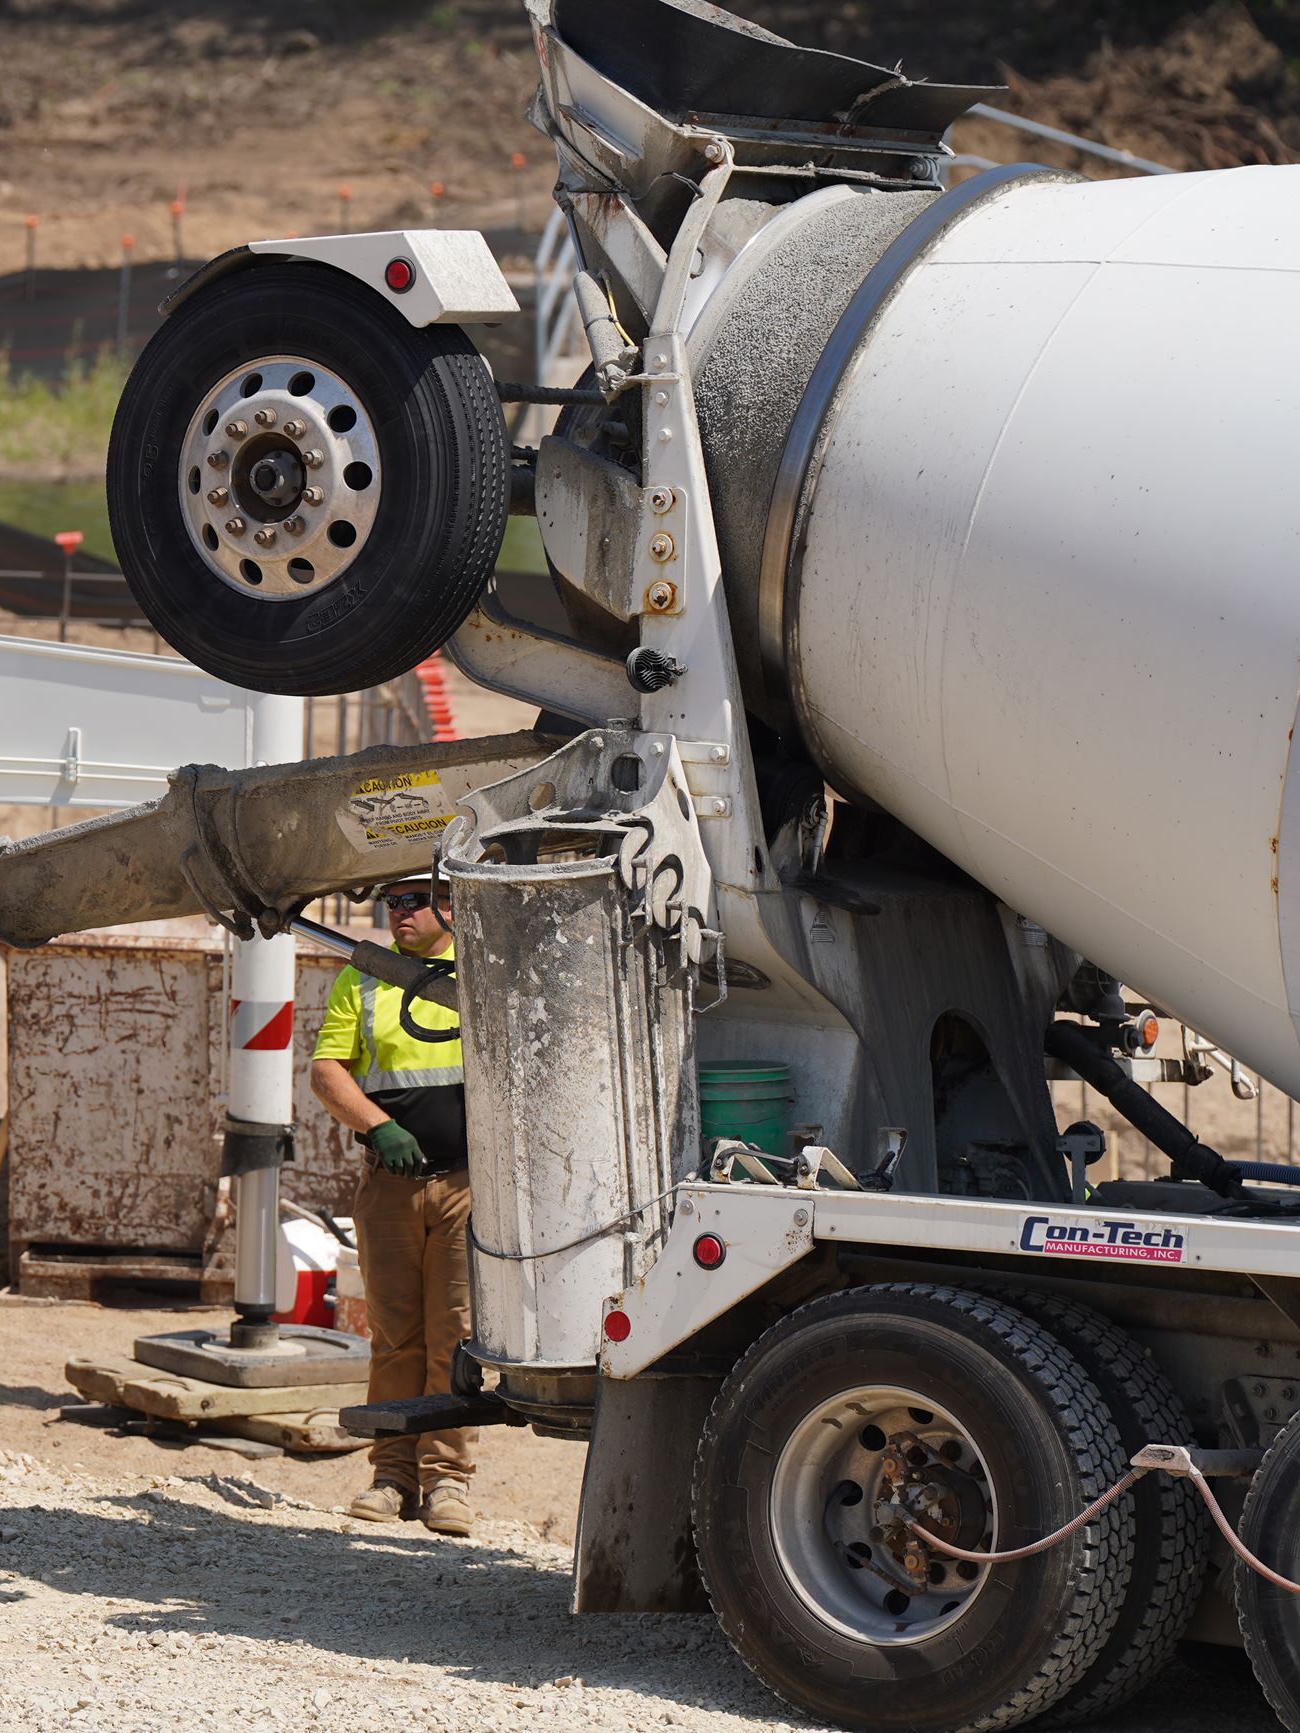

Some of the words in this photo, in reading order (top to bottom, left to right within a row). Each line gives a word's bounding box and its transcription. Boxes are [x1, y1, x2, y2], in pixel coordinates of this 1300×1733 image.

[364, 777, 412, 793] CAUTION
[1045, 1242, 1152, 1259] MANUFACTURING,
[1153, 1250, 1179, 1260] INC.
